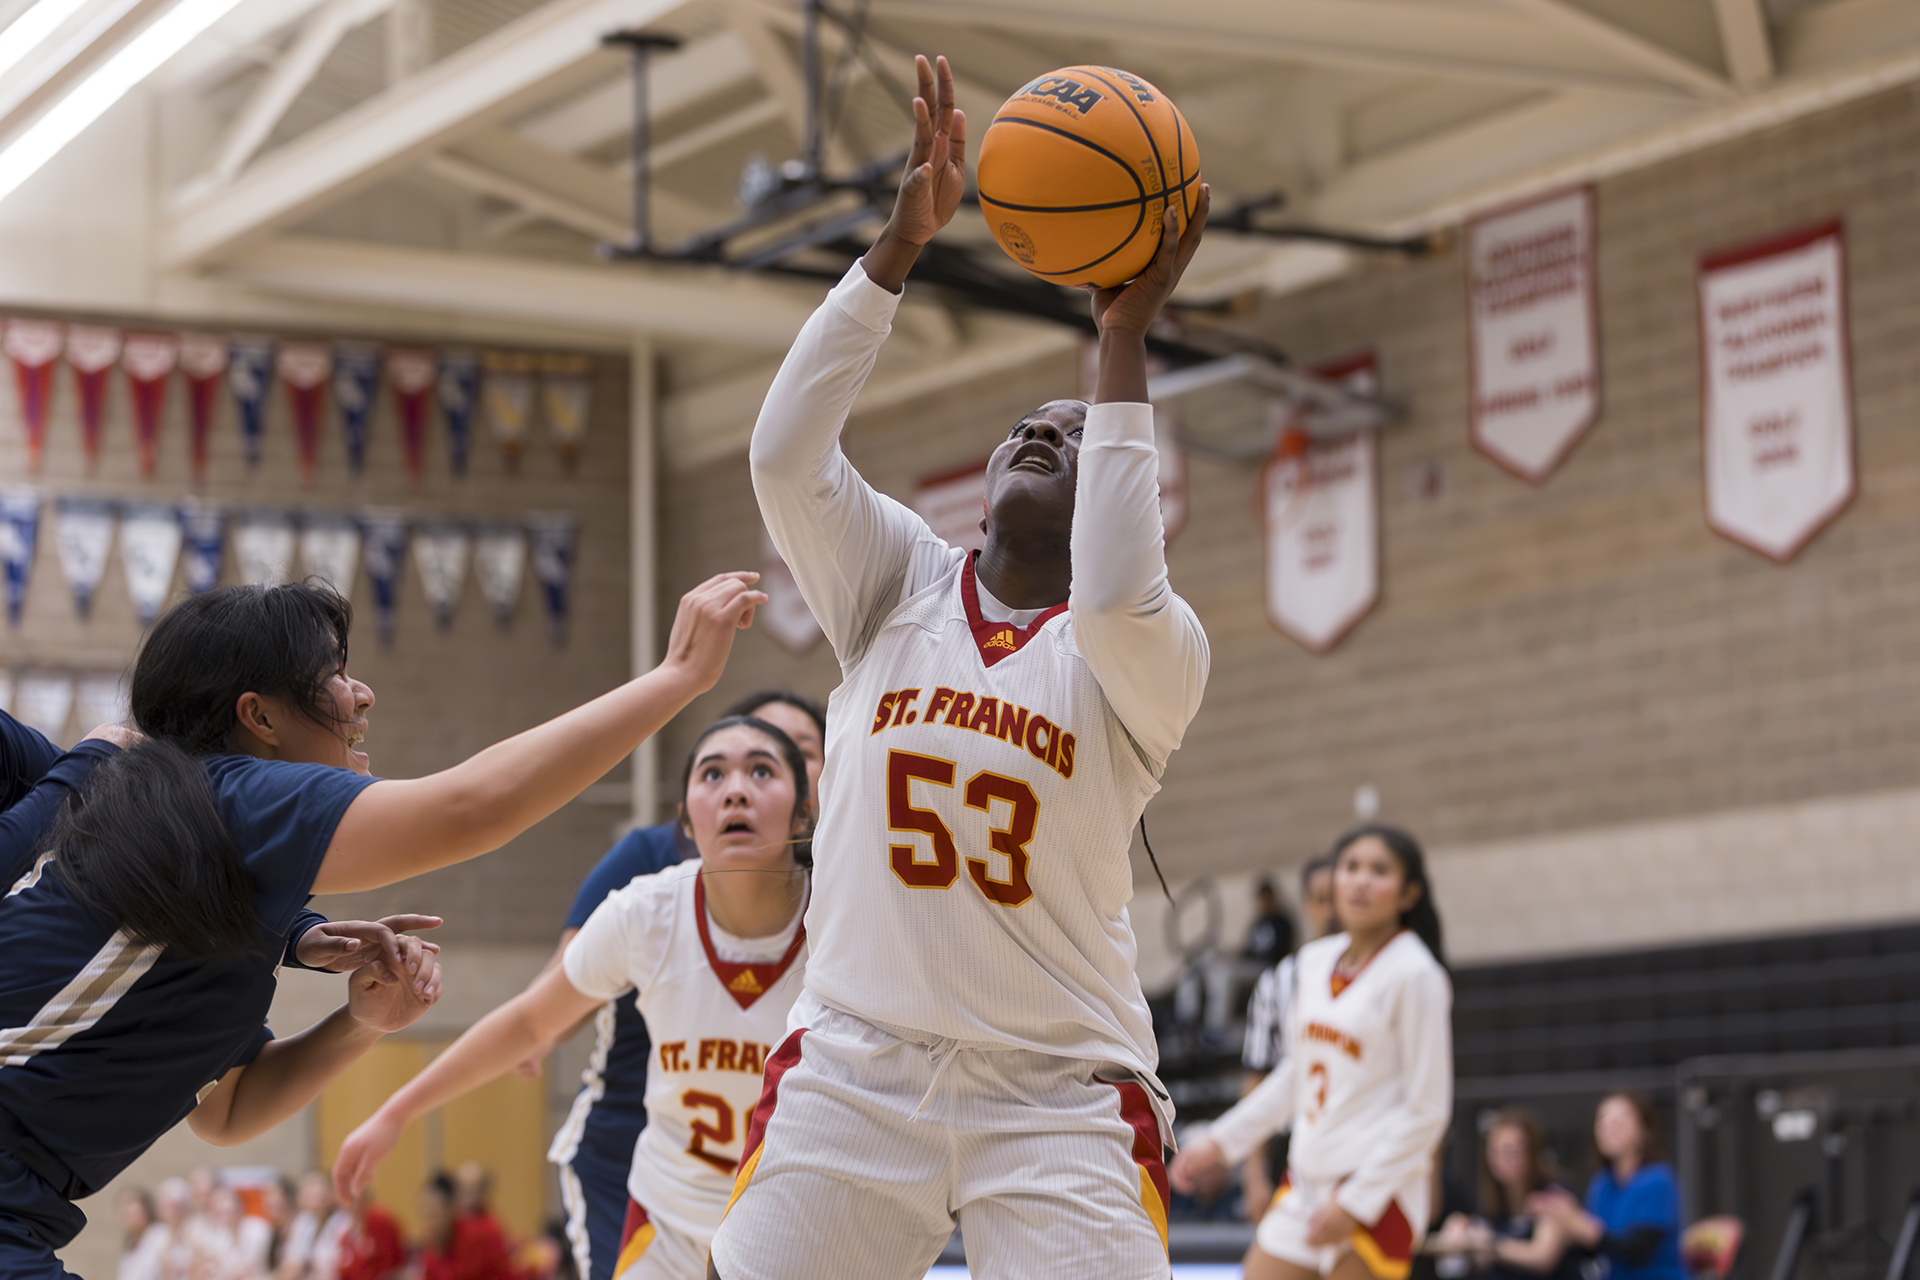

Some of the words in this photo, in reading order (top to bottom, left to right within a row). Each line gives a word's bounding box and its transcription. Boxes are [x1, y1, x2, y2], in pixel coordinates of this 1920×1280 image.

[983, 638, 1017, 651] adidas
[870, 687, 923, 737] ST.
[921, 686, 1076, 780] FRANCIS
[886, 748, 1040, 908] 53
